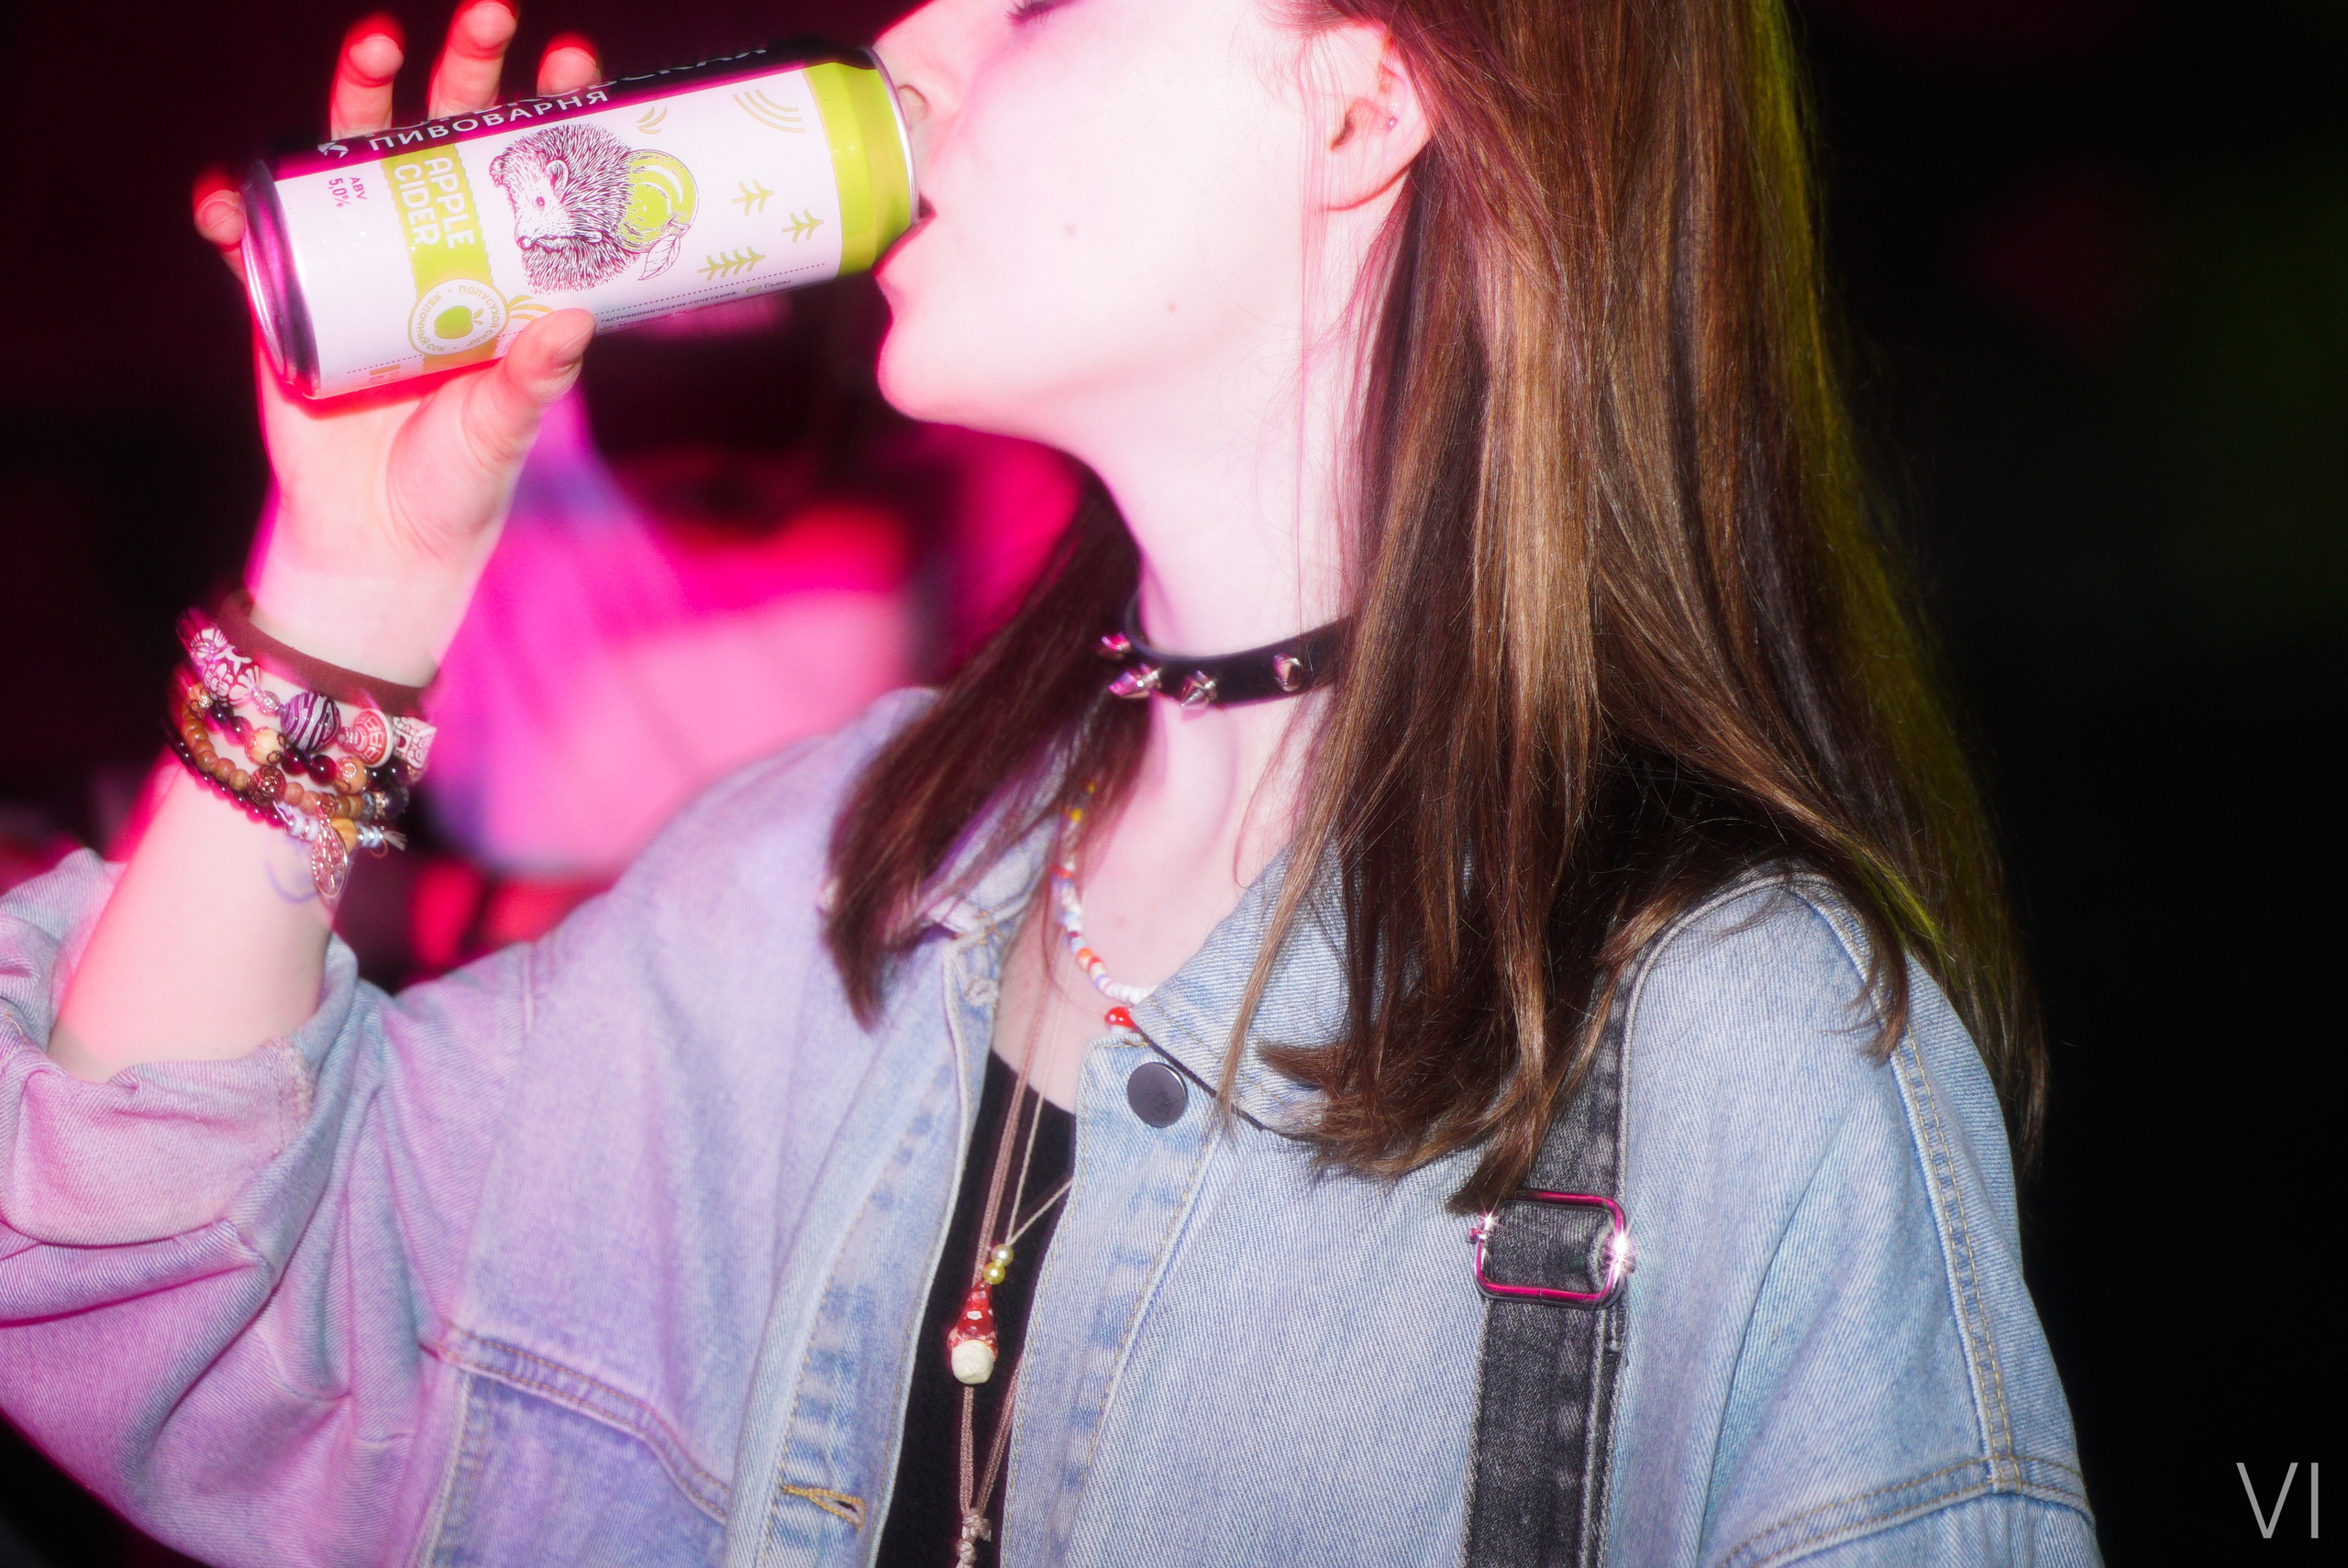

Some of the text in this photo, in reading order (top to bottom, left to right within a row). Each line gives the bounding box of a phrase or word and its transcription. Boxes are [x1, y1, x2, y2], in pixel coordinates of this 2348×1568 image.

[369, 91, 608, 151] ПИВОВАРНЯ
[327, 178, 351, 207] 5,0%
[349, 177, 368, 200] ABV
[393, 164, 440, 246] CIDER
[424, 157, 475, 248] APPLE
